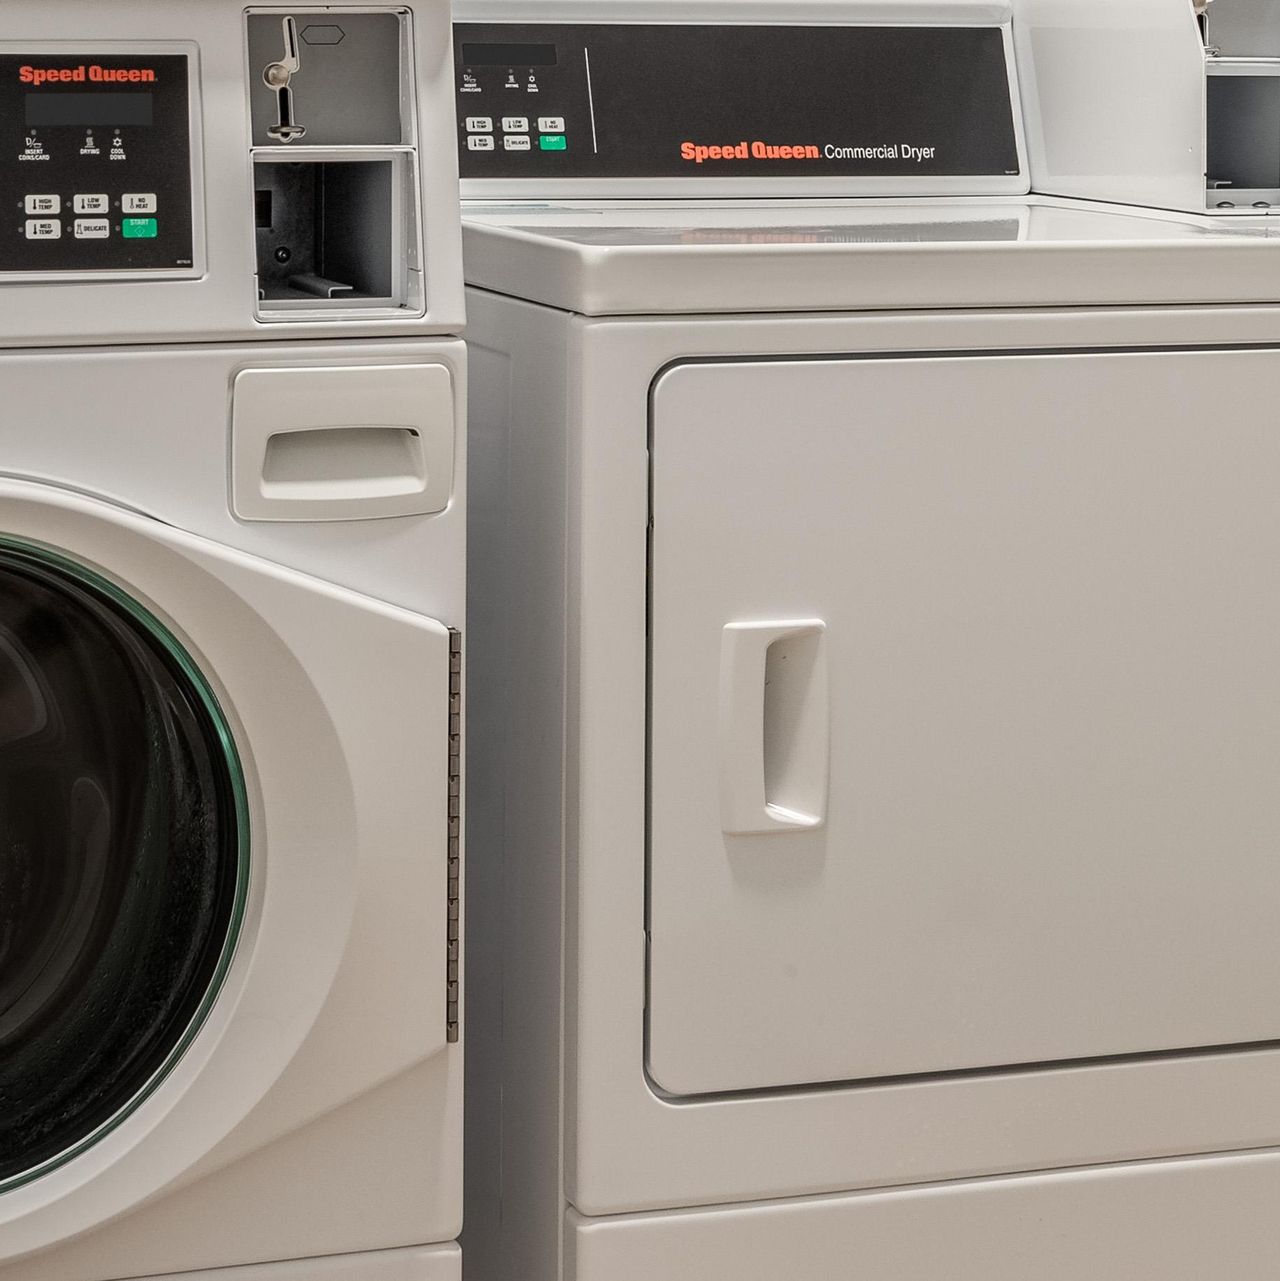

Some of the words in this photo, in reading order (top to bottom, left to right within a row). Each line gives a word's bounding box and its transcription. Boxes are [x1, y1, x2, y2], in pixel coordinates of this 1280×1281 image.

[18, 66, 85, 85] Speed
[88, 65, 155, 82] Queen
[680, 141, 748, 163] Speed
[751, 141, 820, 160] Queen
[824, 144, 897, 159] Commercial
[901, 144, 936, 162] Dryer
